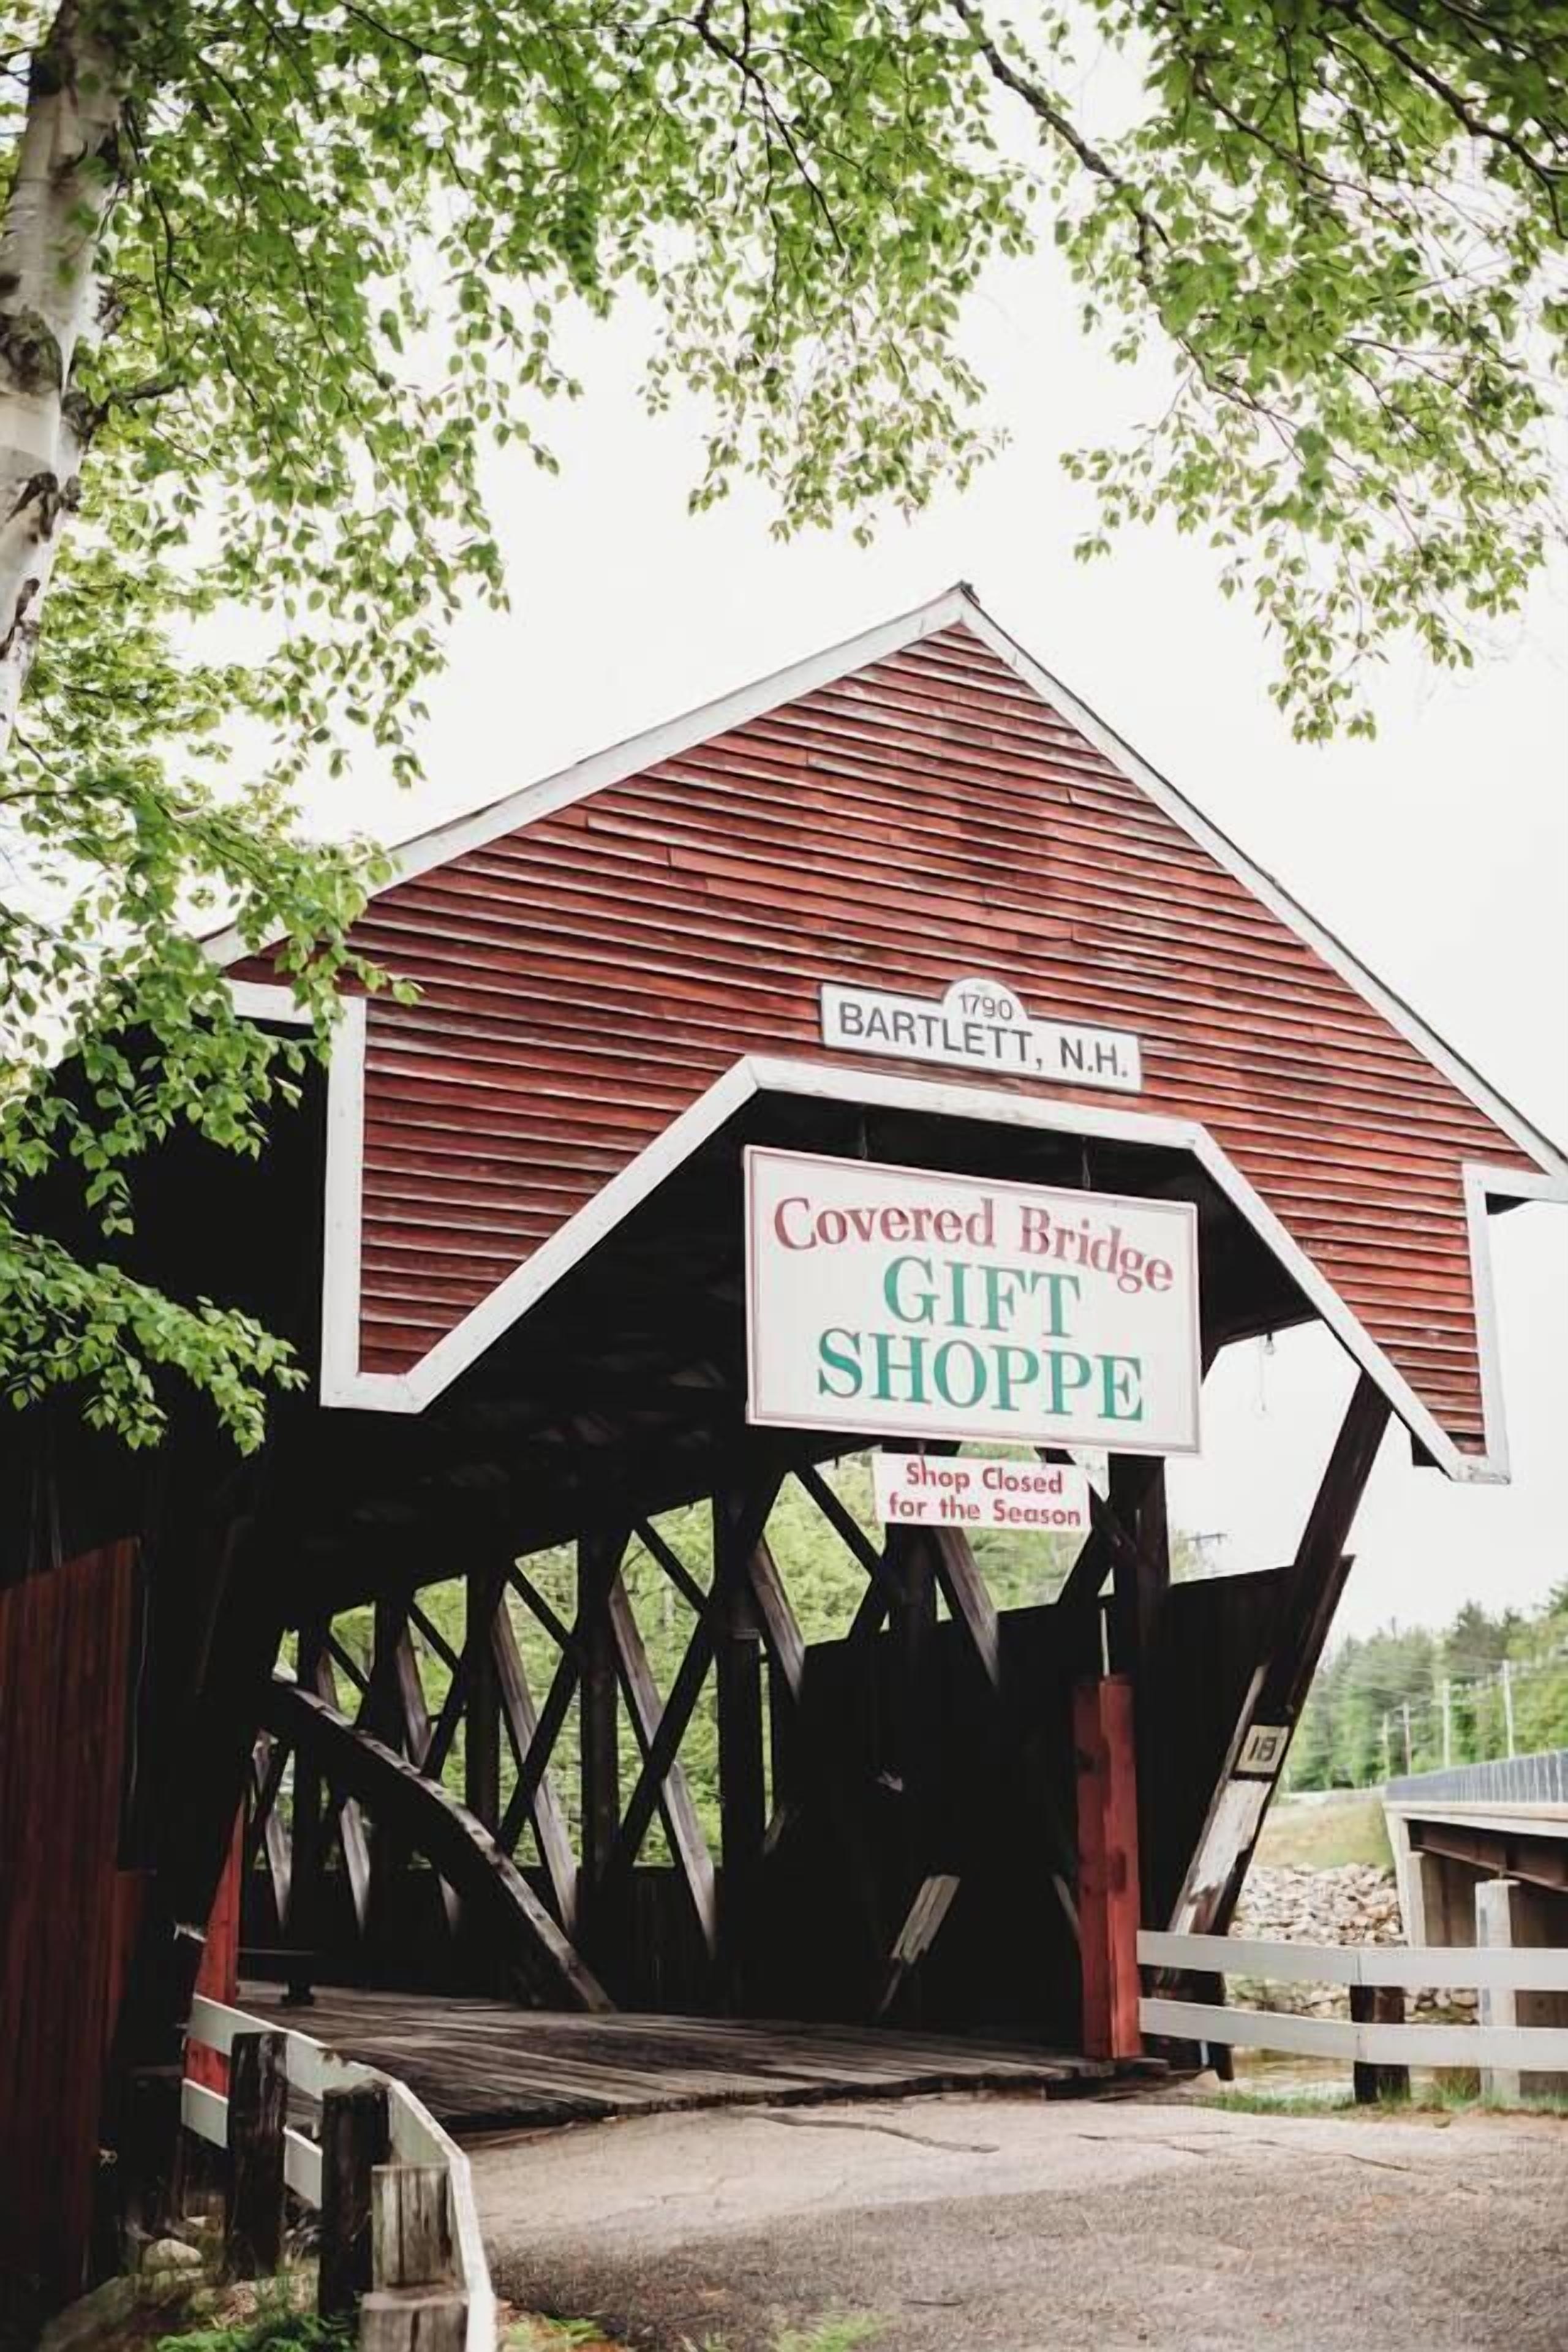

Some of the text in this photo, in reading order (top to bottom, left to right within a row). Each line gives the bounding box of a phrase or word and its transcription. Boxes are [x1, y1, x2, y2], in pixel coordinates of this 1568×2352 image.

[839, 1001, 1129, 1078] BARTLETT, N.H.
[959, 993, 1012, 1020] 1790
[774, 1197, 1174, 1294] Covered Bridge
[883, 1255, 1081, 1339] GIFT
[818, 1327, 1143, 1422] SHOPPE
[889, 1491, 1082, 1527] for the Season
[906, 1461, 1063, 1494] Shop Closed
